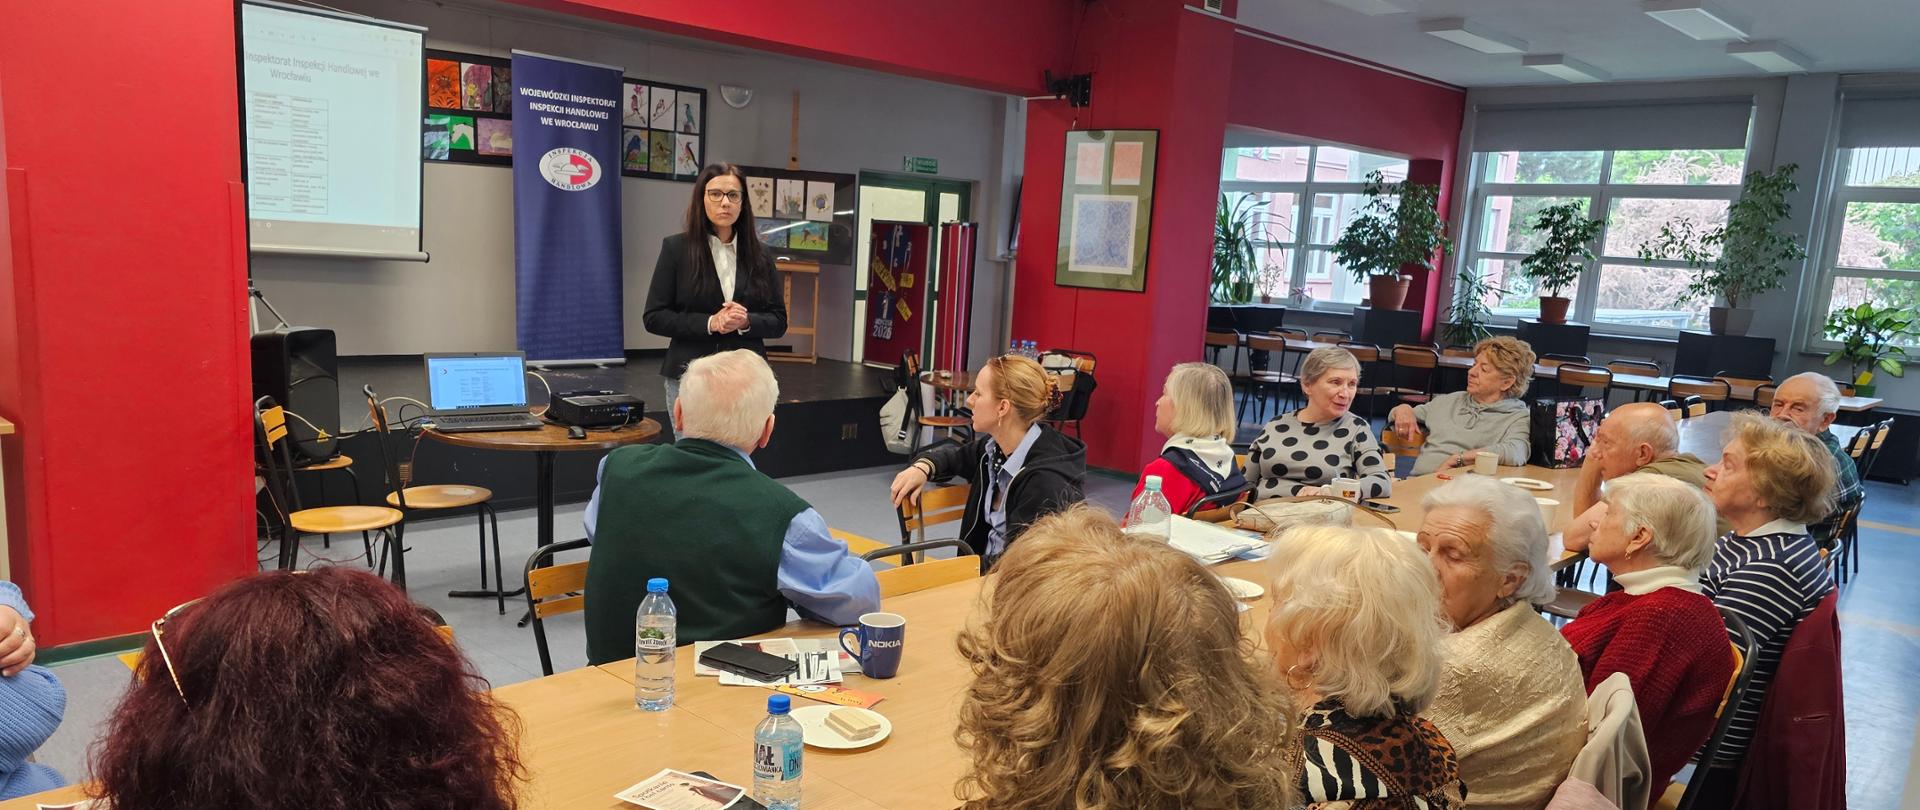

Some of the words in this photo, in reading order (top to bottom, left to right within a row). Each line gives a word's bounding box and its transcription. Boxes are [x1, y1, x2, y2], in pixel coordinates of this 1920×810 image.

[246, 52, 291, 66] Inspektorat
[328, 63, 367, 78] Handlowej
[368, 69, 380, 78] we
[270, 69, 312, 83] Wrocławiu
[520, 87, 570, 102] WOJEWÓDZKI
[571, 94, 616, 108] INSPEKTORAT
[529, 102, 564, 114] INSPEKCJI
[565, 107, 609, 120] HANDLOWEJ
[540, 117, 553, 126] WE
[554, 119, 599, 131] WROCŁAWIU
[548, 148, 592, 162] INSPEKCJA
[551, 178, 592, 190] HANDLOWA
[868, 639, 901, 648] NOKIA
